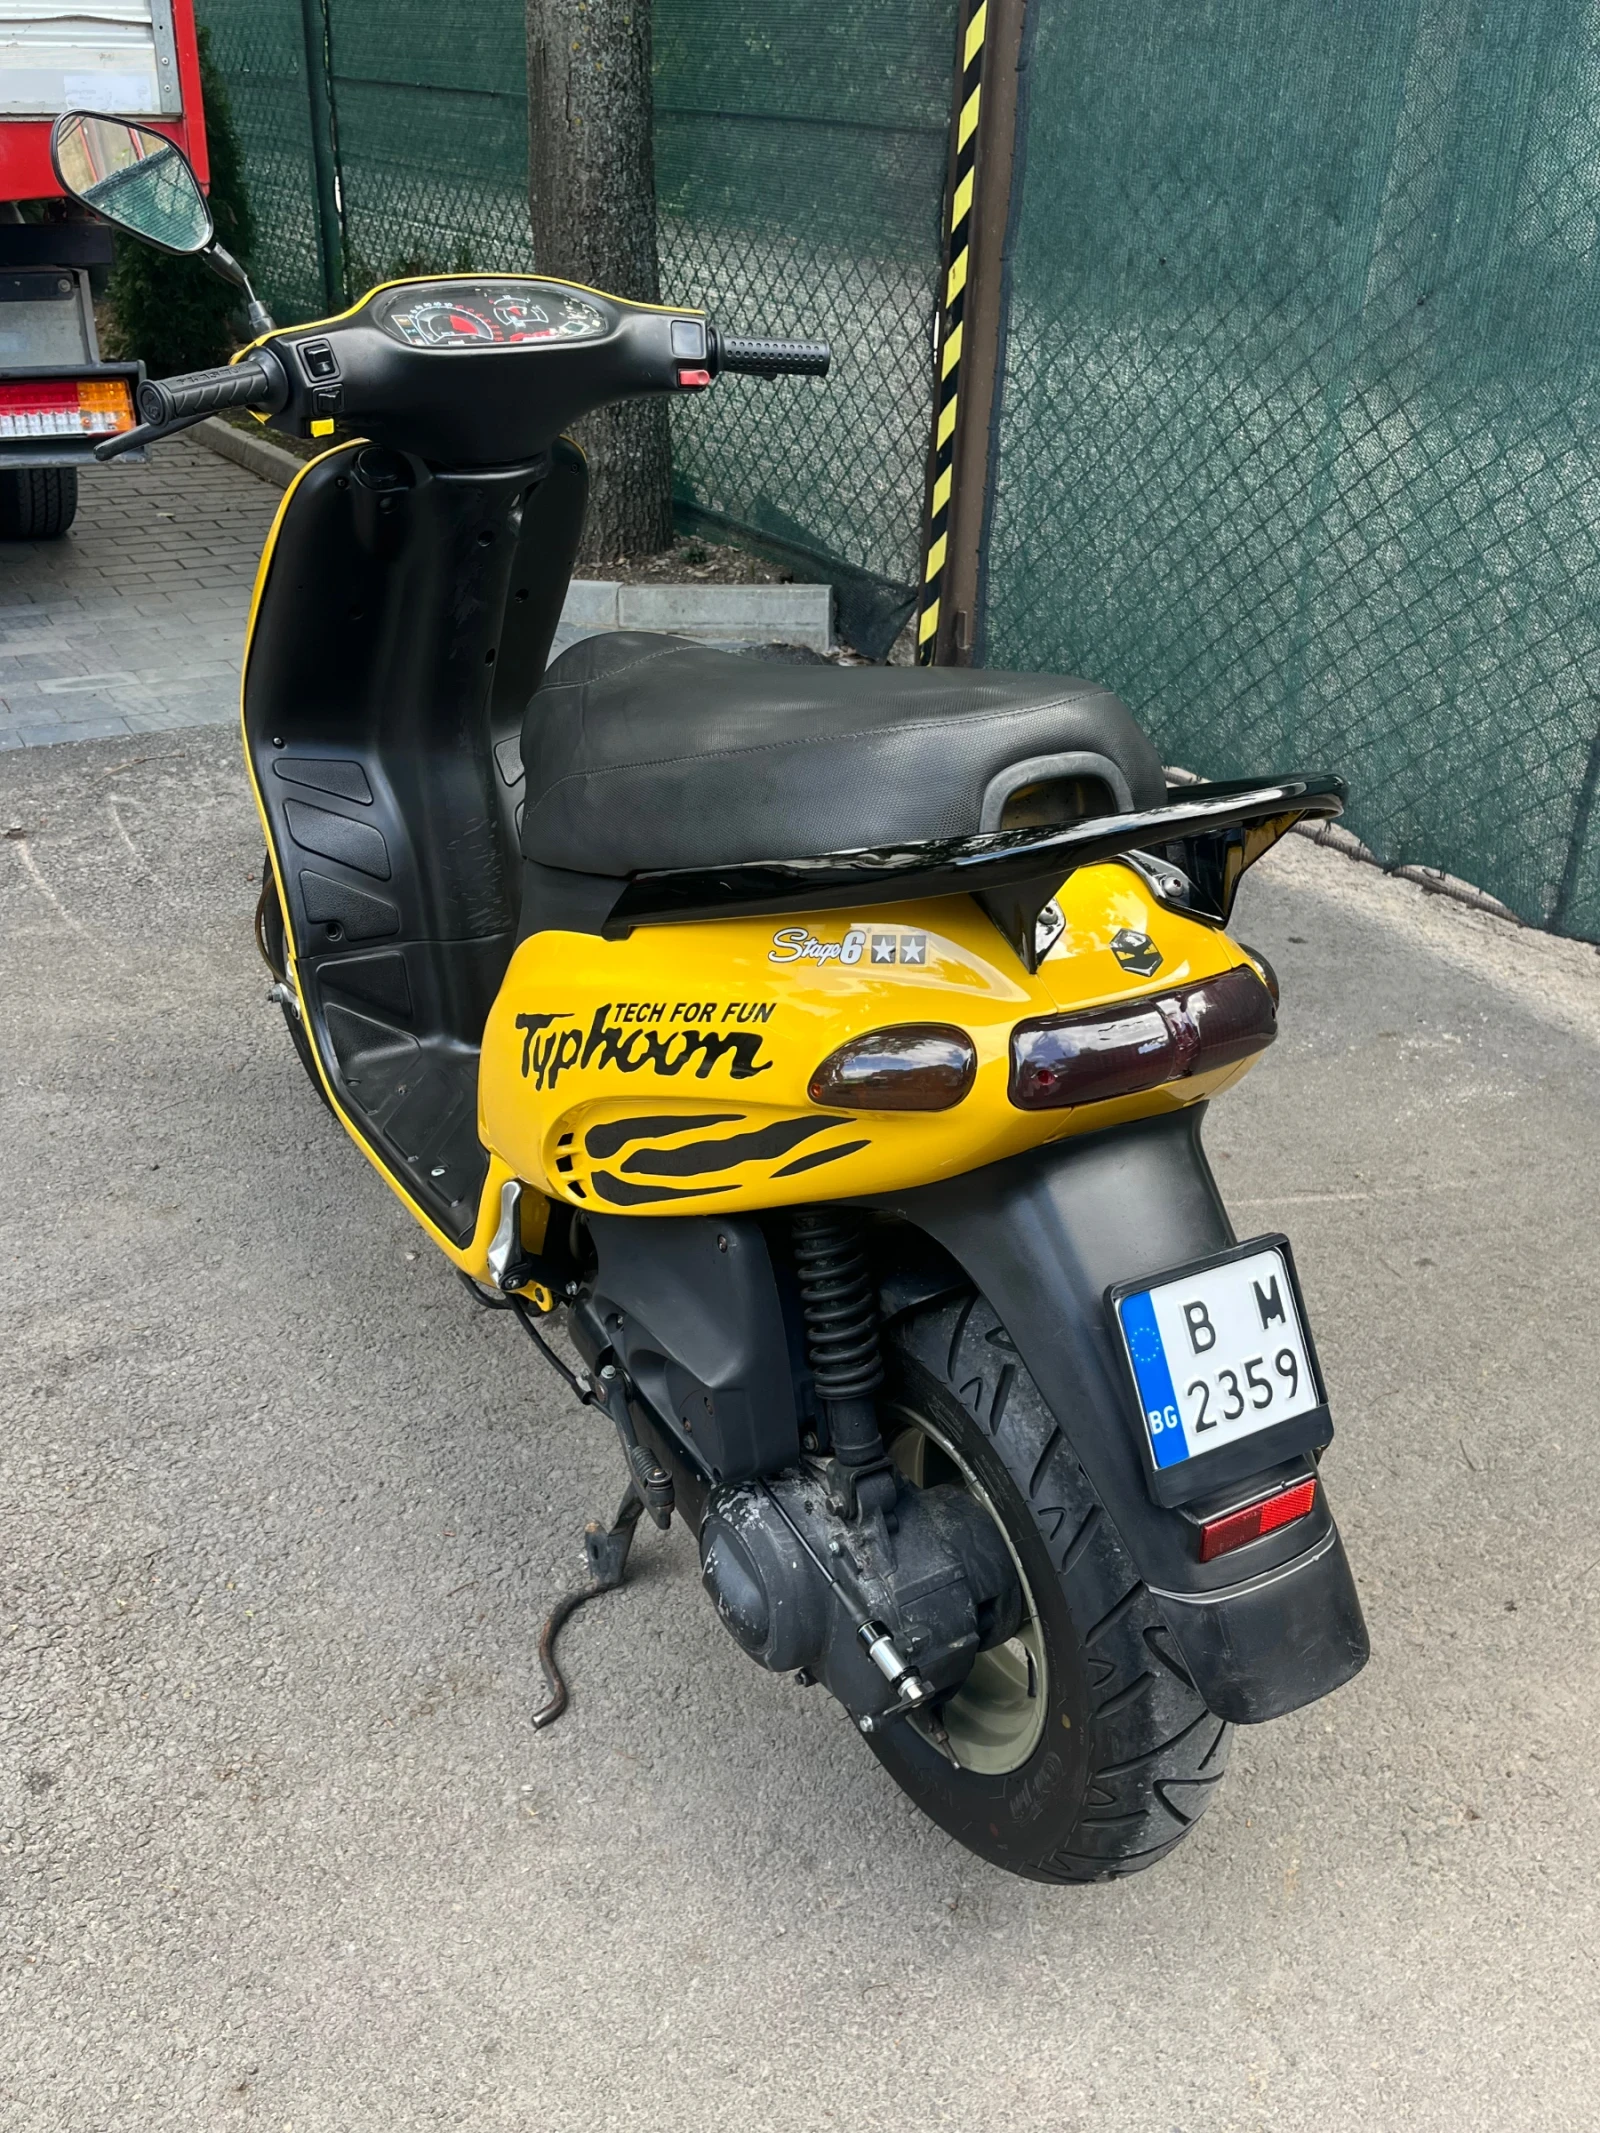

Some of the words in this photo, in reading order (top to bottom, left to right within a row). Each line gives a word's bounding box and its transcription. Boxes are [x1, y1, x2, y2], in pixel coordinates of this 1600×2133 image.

[768, 927, 866, 967] Stage6
[614, 1003, 666, 1022] TECH
[669, 1003, 716, 1022] FOR
[721, 1003, 777, 1022] FUN
[515, 1003, 773, 1091] Typhoon
[1183, 1300, 1216, 1354] B
[1252, 1274, 1286, 1330] M
[1148, 1405, 1178, 1435] BG
[1187, 1348, 1298, 1433] 2359
